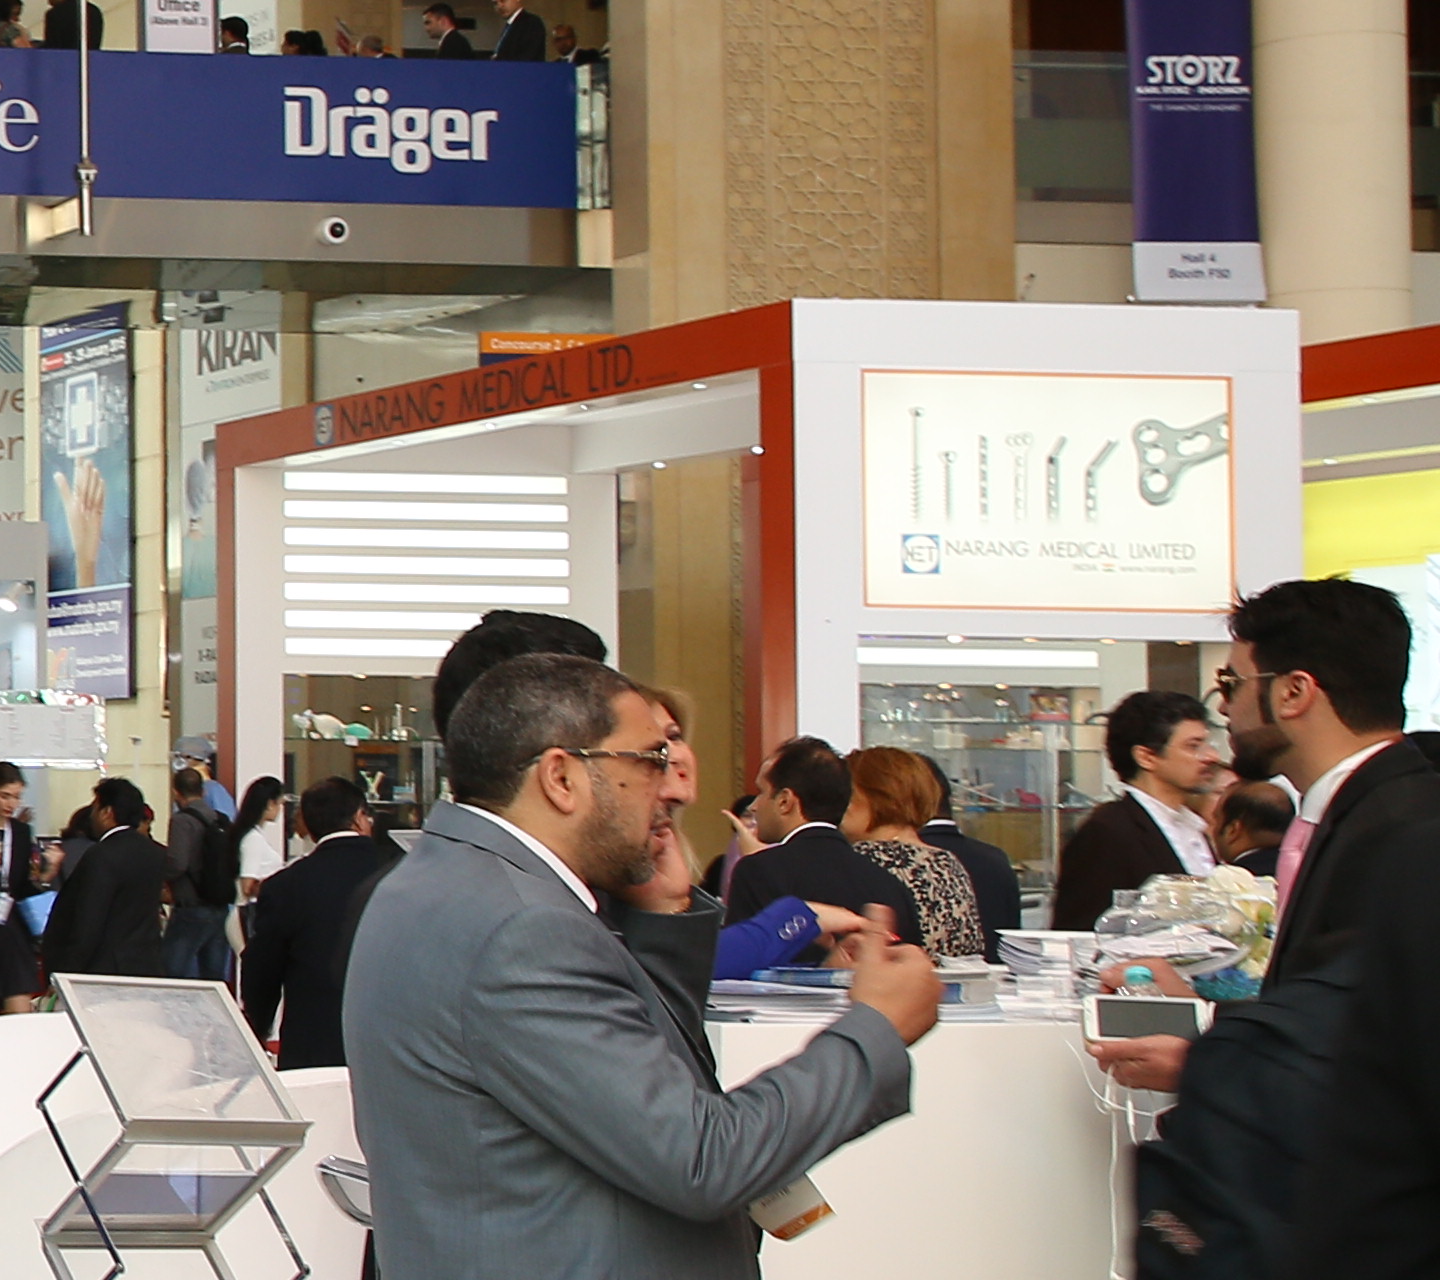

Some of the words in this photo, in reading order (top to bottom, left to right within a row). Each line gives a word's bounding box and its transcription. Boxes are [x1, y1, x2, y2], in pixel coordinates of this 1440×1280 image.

[1145, 55, 1242, 85] STORZ
[285, 86, 498, 173] Dräger
[339, 383, 444, 442] NARANG
[459, 356, 571, 418] MEDICAL
[945, 540, 1029, 558] NARANG
[1038, 541, 1119, 560] MEDICAL
[1129, 542, 1196, 561] LIMITED
